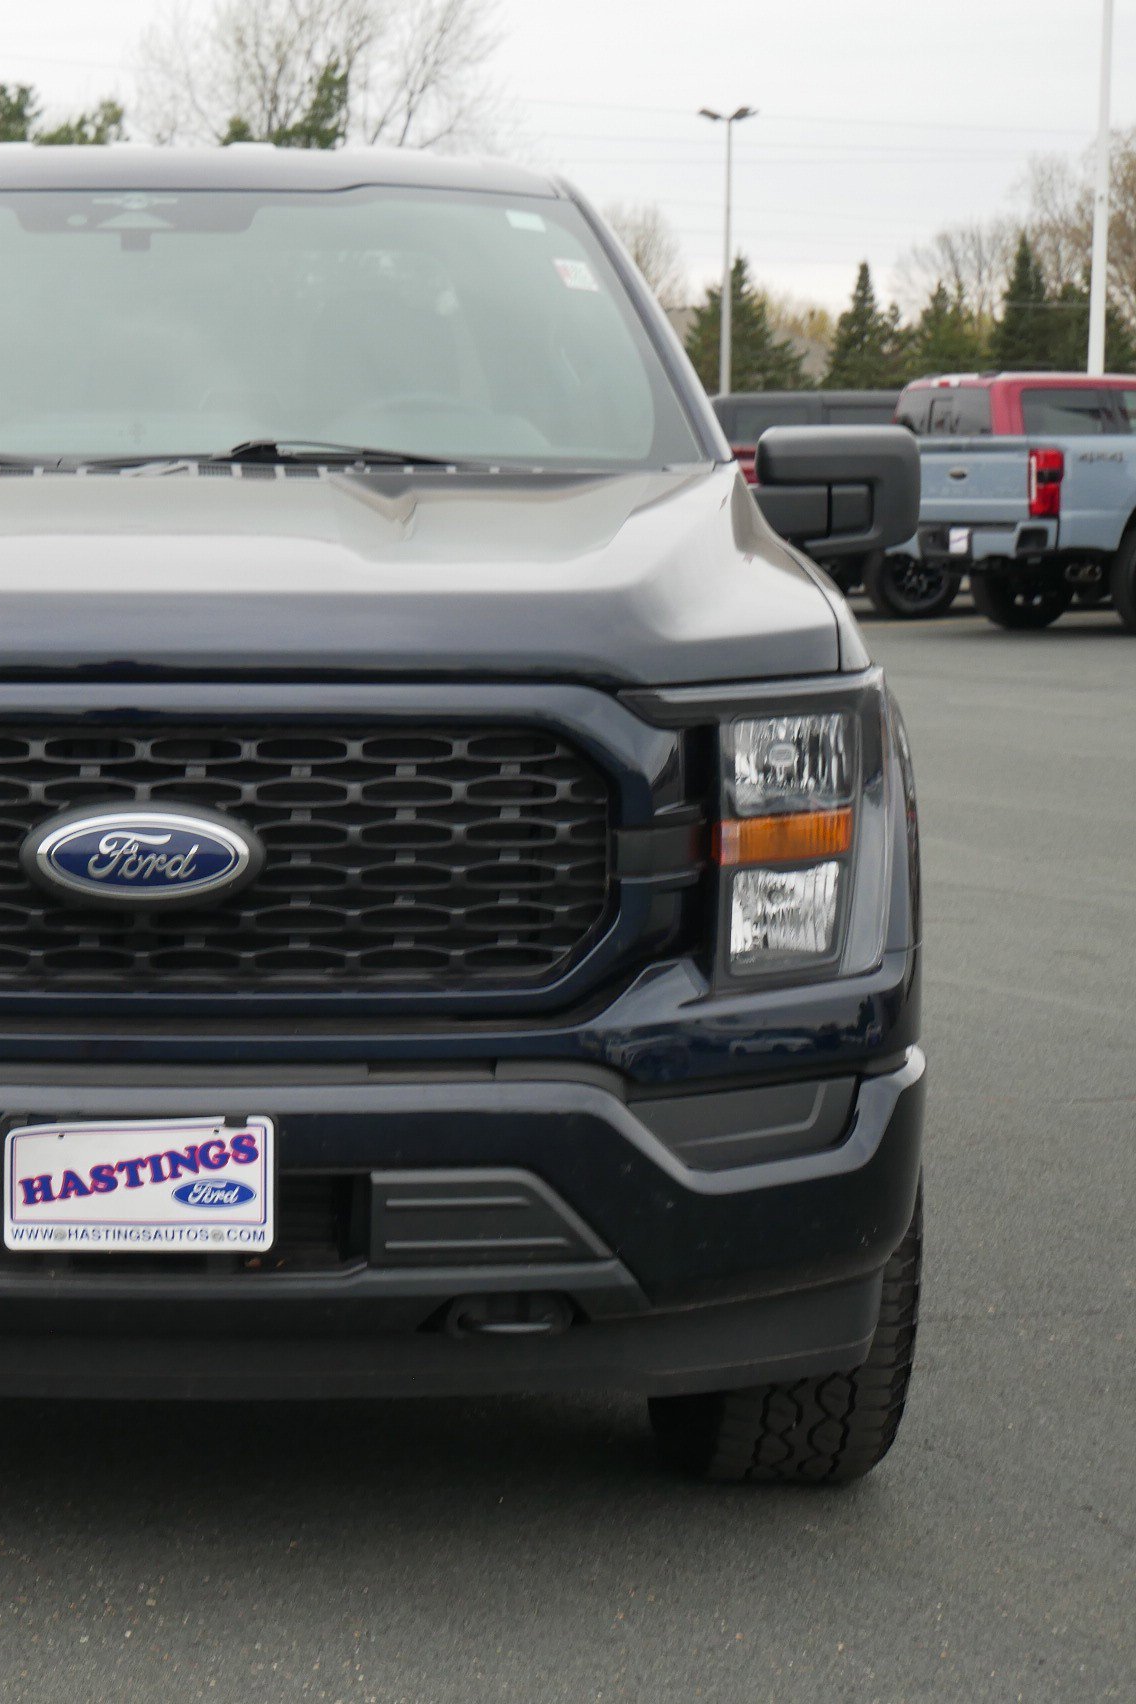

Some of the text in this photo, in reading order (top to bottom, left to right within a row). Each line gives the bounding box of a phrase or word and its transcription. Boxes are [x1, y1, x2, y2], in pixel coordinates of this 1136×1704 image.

[88, 831, 199, 880] Ford
[18, 1134, 260, 1205] HASTINGS
[188, 1179, 240, 1204] Ford
